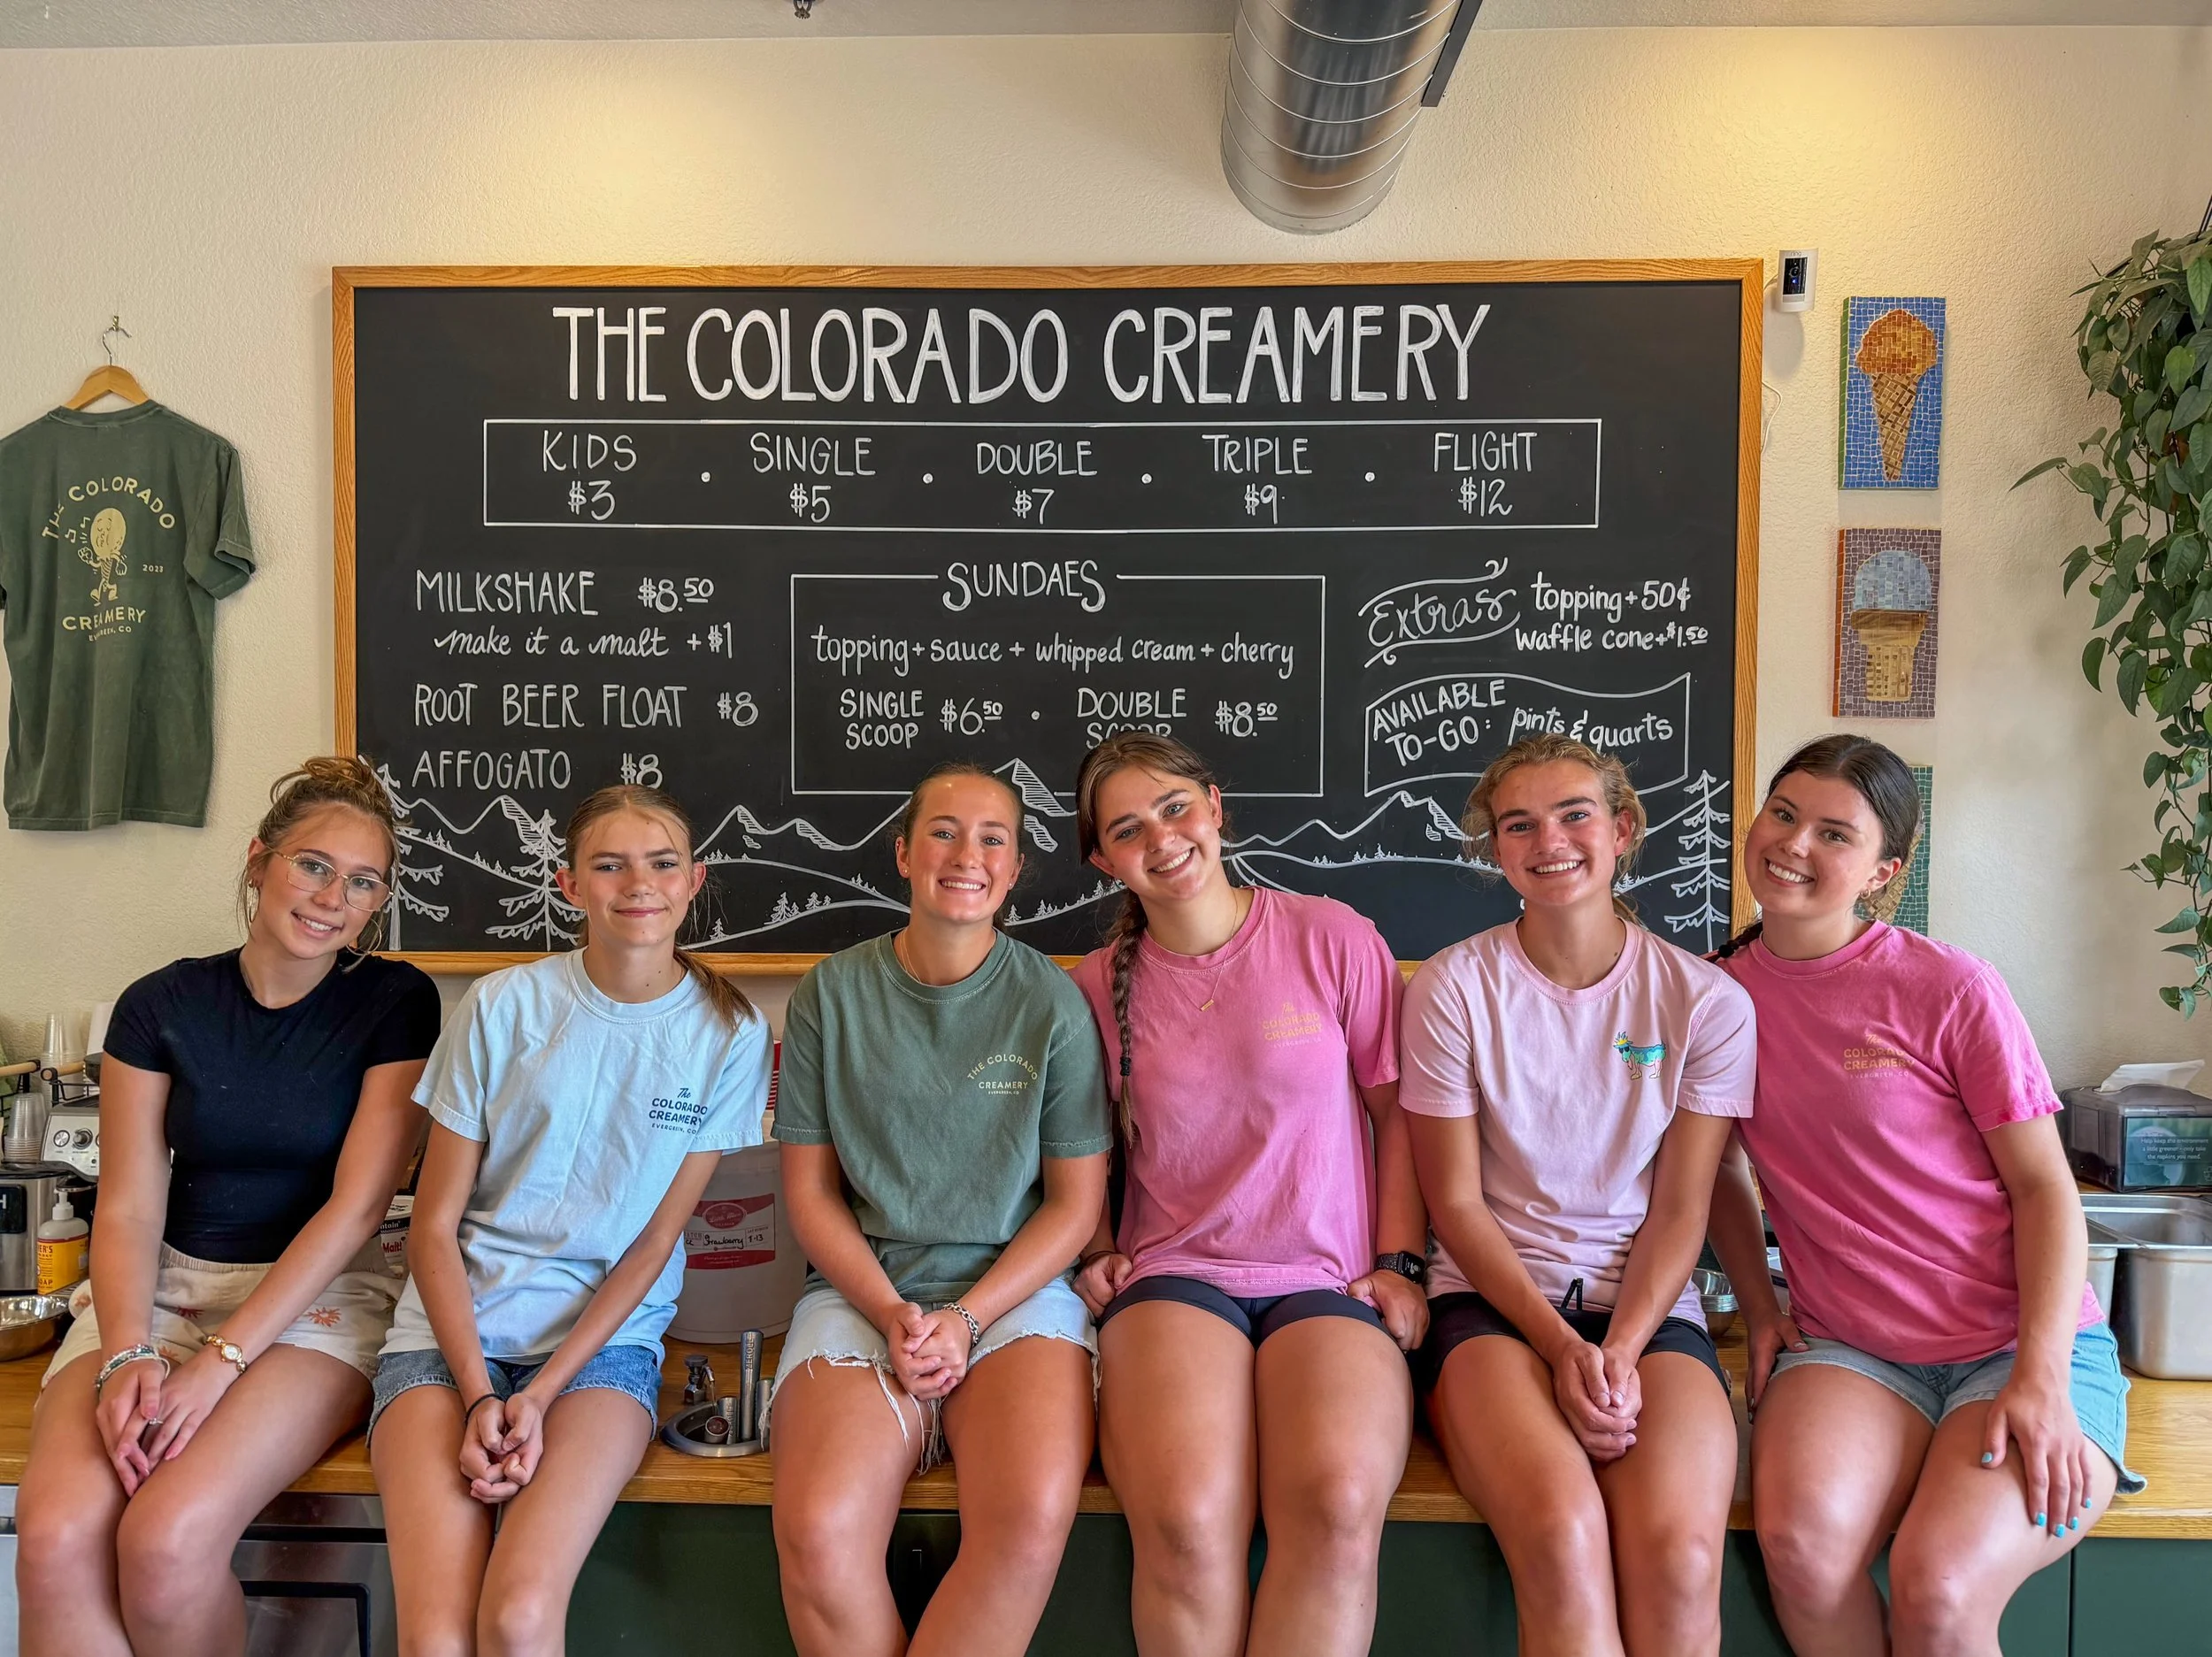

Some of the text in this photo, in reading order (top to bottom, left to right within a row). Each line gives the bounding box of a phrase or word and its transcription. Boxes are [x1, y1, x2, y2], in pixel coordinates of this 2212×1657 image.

[552, 303, 1491, 404] THE COLORADO CREAMERY
[542, 429, 1538, 477] KIDS SINGLE DOUBLE TRIPLE FLIGHT
[68, 476, 175, 529] COLORADO
[567, 475, 1513, 525] $3 $5 $7 $9 $12
[142, 564, 164, 573] 2023
[942, 559, 1106, 613] SUNDAES
[416, 569, 715, 616] MILKSHAKE $8.50
[62, 606, 146, 631] CREAMERY
[118, 625, 132, 633] CO
[434, 625, 511, 656] make
[525, 625, 549, 655] it
[559, 636, 580, 656] a
[588, 626, 670, 657] malt
[1367, 587, 1517, 648] Extras
[1516, 617, 1594, 653] waffle
[1035, 632, 1124, 674] whipped
[1131, 639, 1196, 662] cream
[1221, 631, 1294, 680] cherry
[415, 682, 759, 729] ROOT BEER FLOAT $8
[839, 688, 1279, 738] SINGLE $6.50 DOUBLE $8.50
[1372, 679, 1507, 741] AVAILABLE
[845, 722, 919, 750] SCOOP
[1507, 707, 1566, 746] pints
[1588, 713, 1675, 756] quarts
[411, 748, 664, 790] AFFOGATO $8
[967, 1054, 1038, 1080] THE COLORADO
[652, 1097, 708, 1116] COLORADO
[677, 1087, 691, 1099] The
